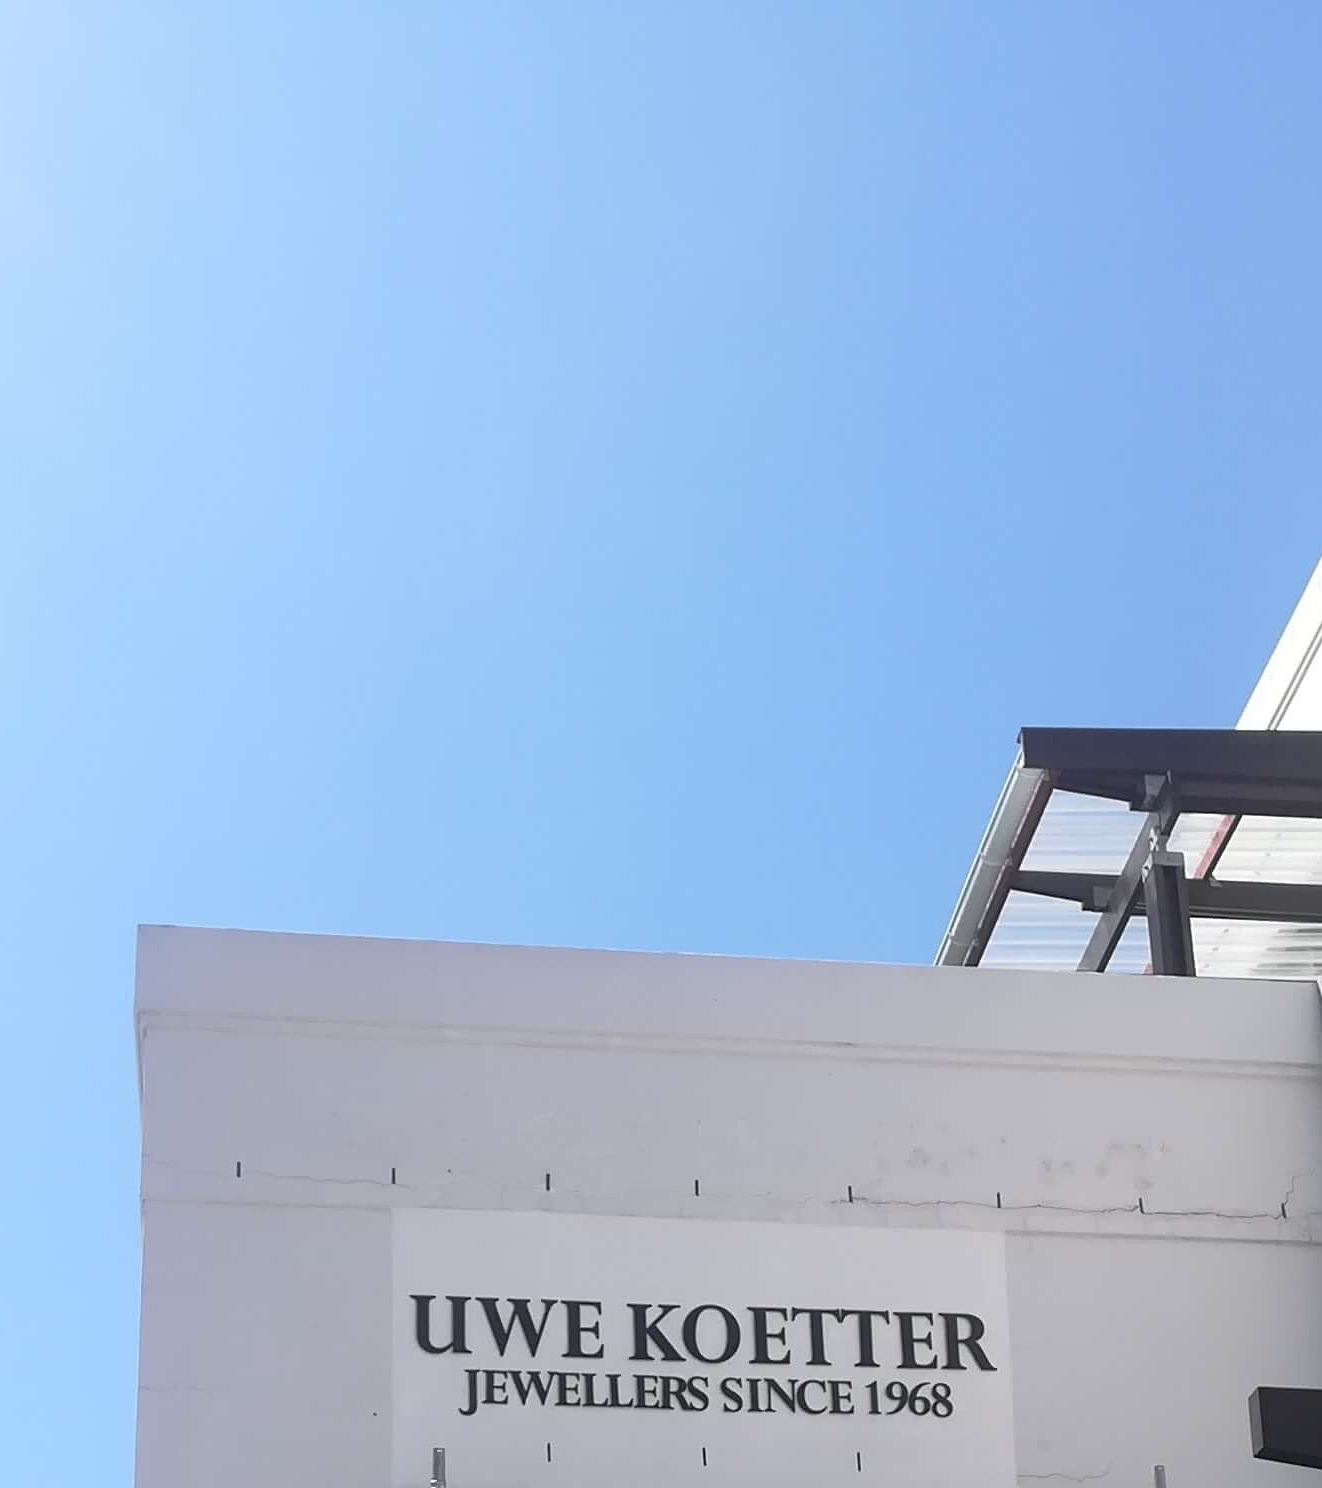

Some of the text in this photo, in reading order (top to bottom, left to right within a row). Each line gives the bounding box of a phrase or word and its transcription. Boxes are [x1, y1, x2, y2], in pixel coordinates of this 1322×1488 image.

[409, 1294, 998, 1372] UWE KOETTER
[458, 1369, 954, 1418] JEWELLERS SINCE 1968
